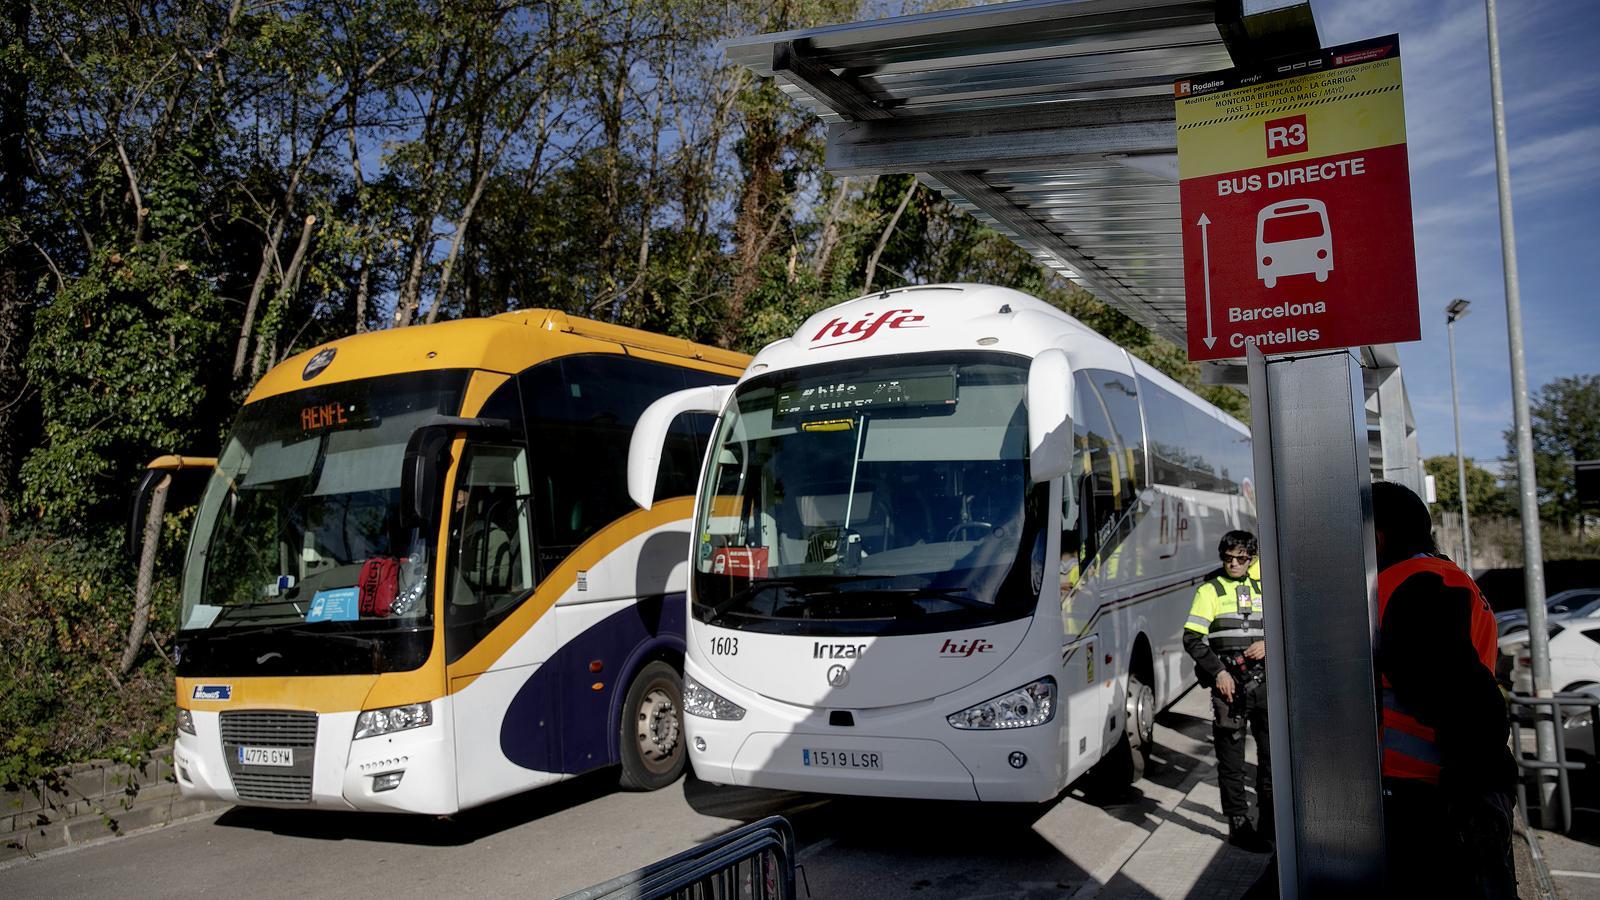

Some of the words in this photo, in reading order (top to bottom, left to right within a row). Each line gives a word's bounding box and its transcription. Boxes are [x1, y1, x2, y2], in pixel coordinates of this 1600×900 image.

[1184, 94, 1220, 105] Modificació
[1232, 88, 1251, 97] servei
[1253, 86, 1265, 94] per
[1265, 81, 1283, 90] obres
[1360, 64, 1371, 73] por
[1372, 61, 1390, 69] obras
[1192, 79, 1225, 92] Rodalies
[1215, 94, 1256, 108] MONTCADA
[1257, 84, 1303, 100] BIFURCACIÓ
[1310, 82, 1320, 90] LA
[1321, 74, 1357, 87] GARRIGA
[1226, 106, 1243, 114] FASE
[1255, 101, 1269, 109] DEL
[1271, 96, 1288, 106] 7/10
[1297, 91, 1318, 101] MAIG
[1323, 85, 1345, 96] MAYO
[1268, 122, 1306, 150] R3
[1217, 175, 1262, 197] BUS
[1267, 157, 1366, 189] DIRECTE
[1228, 300, 1326, 323] Barcelona
[809, 308, 929, 350] hife
[1229, 327, 1320, 349] Centelles
[301, 402, 348, 430] RENFE
[710, 636, 739, 657] 1603
[813, 640, 867, 659] Irizar
[939, 638, 996, 659] hife
[246, 749, 268, 763] 4776
[813, 751, 847, 766] 1519
[852, 752, 879, 768] LSR
